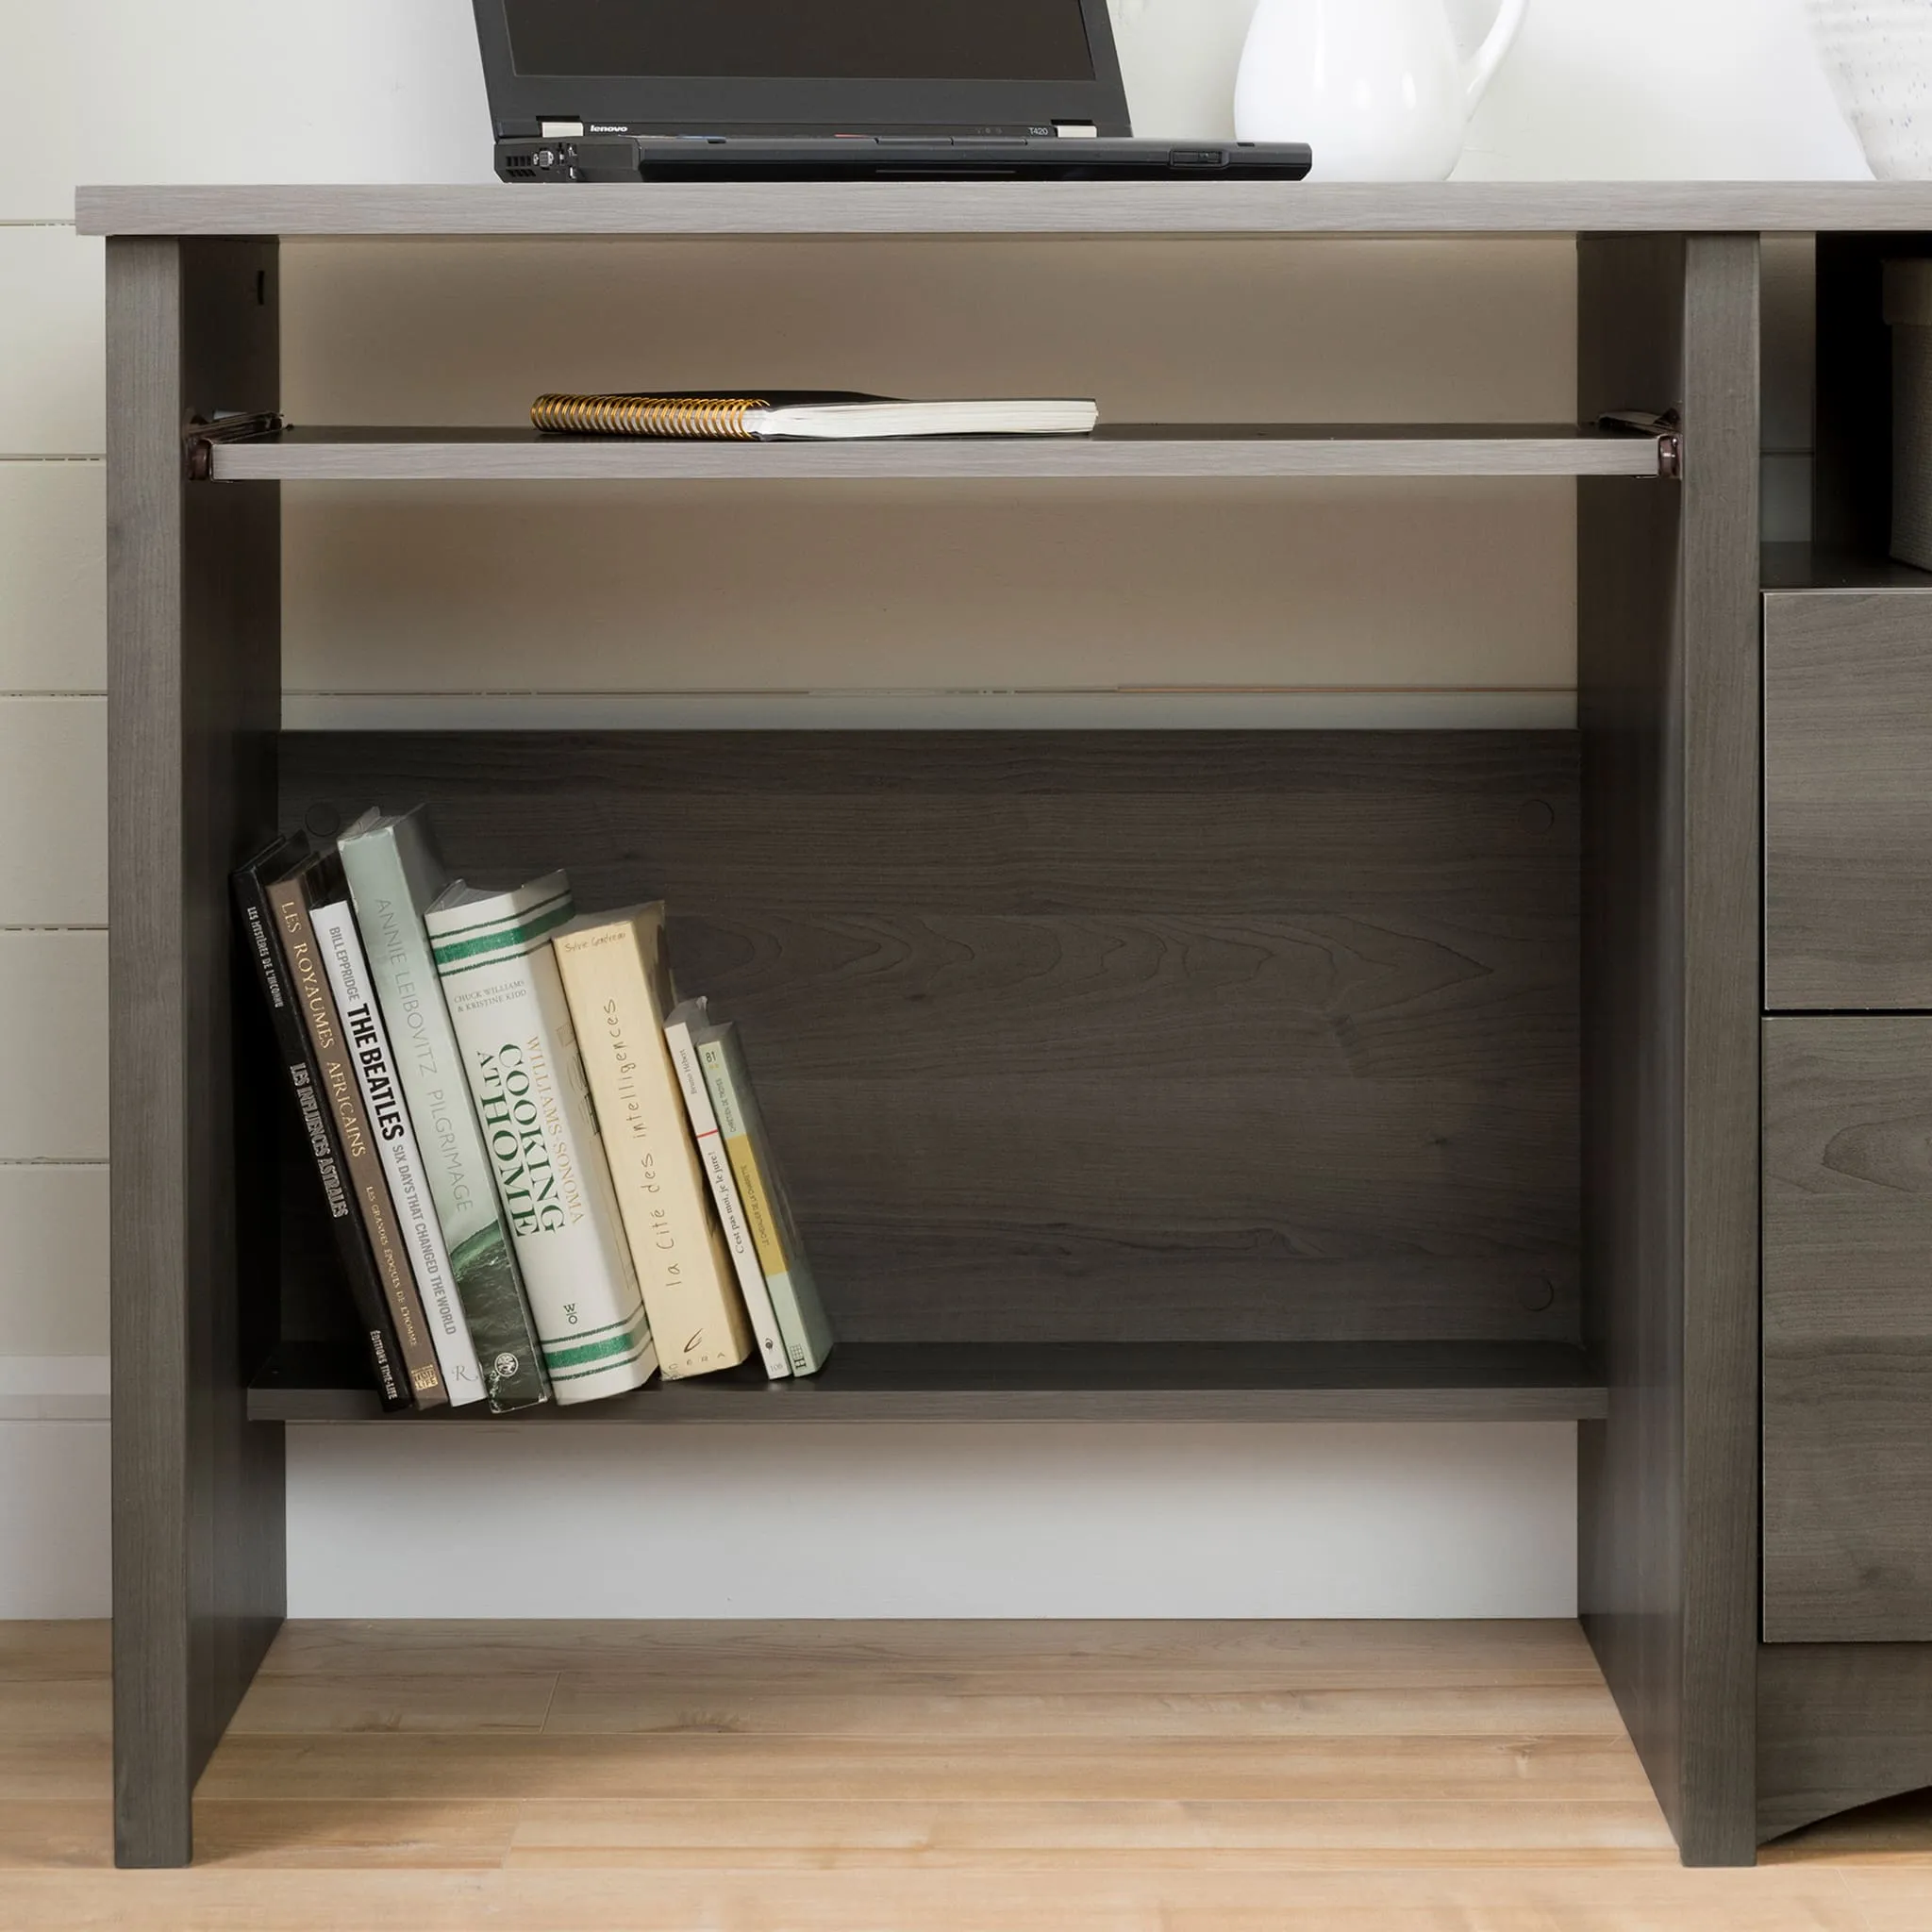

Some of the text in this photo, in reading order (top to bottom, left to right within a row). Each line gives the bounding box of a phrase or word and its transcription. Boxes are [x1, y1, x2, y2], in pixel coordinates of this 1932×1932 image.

[590, 125, 628, 133] lenovo
[1029, 127, 1048, 136] T420
[247, 907, 258, 920] LES
[262, 956, 271, 969] DE
[454, 979, 525, 1004] CHUCK WILLIAMS
[466, 994, 505, 1011] KRISTINE
[506, 990, 527, 1002] KIDD
[281, 901, 367, 1158] LES ROYAUMES AFRICAINS
[375, 898, 474, 1212] ANNIE LEIBOVITZ PILGRIMAGE
[290, 1062, 310, 1087] LES
[604, 998, 648, 1139] intelligences
[706, 1052, 717, 1063] 81
[329, 926, 457, 1336] BILL EPPRIDGE THE BEATLES SIX DAYS THAT CHANGED THE WORLD
[476, 1050, 540, 1237] AT HOME
[498, 1043, 566, 1234] COOKING
[641, 1152, 661, 1193] des
